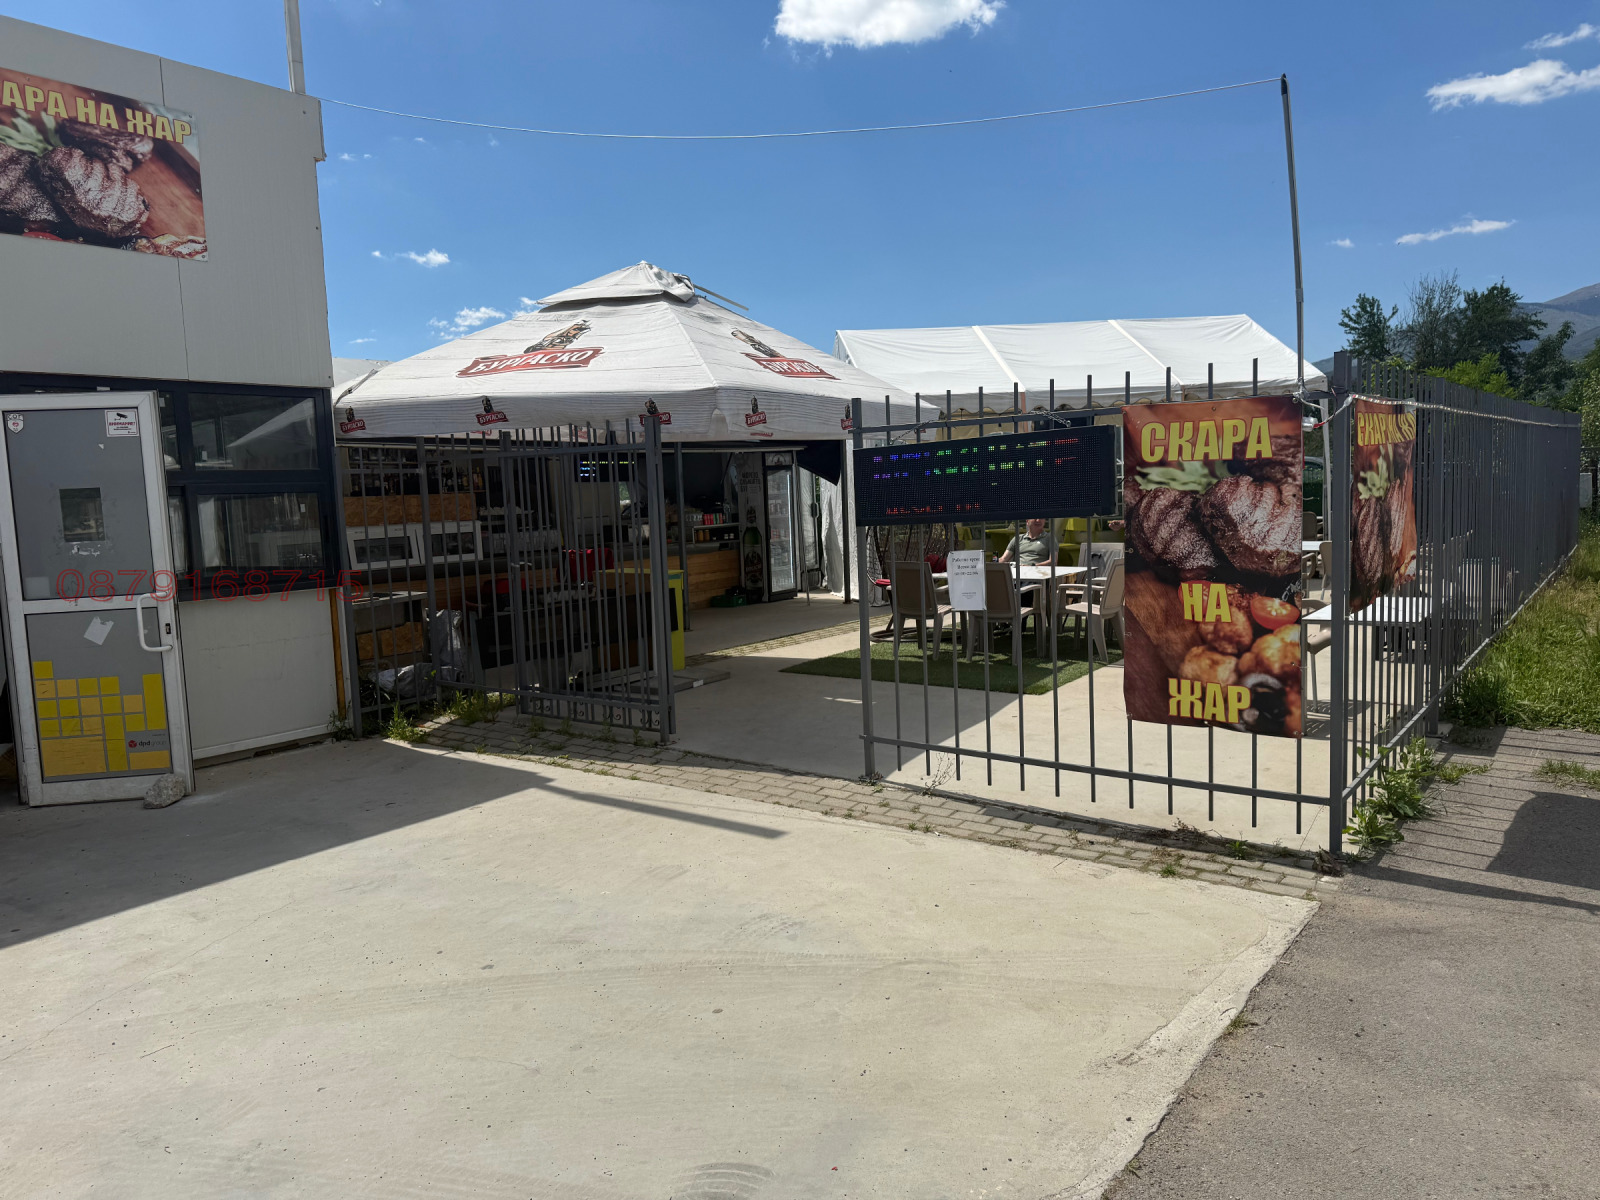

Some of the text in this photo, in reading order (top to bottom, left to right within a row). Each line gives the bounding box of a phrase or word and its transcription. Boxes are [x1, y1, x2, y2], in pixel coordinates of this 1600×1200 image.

[75, 96, 120, 130] НА
[125, 107, 192, 145] ЖАР
[467, 350, 595, 373] БУРГАСКО
[1140, 416, 1274, 463] СКАРА
[1181, 582, 1232, 623] НА
[1168, 677, 1251, 723] ЖАР
